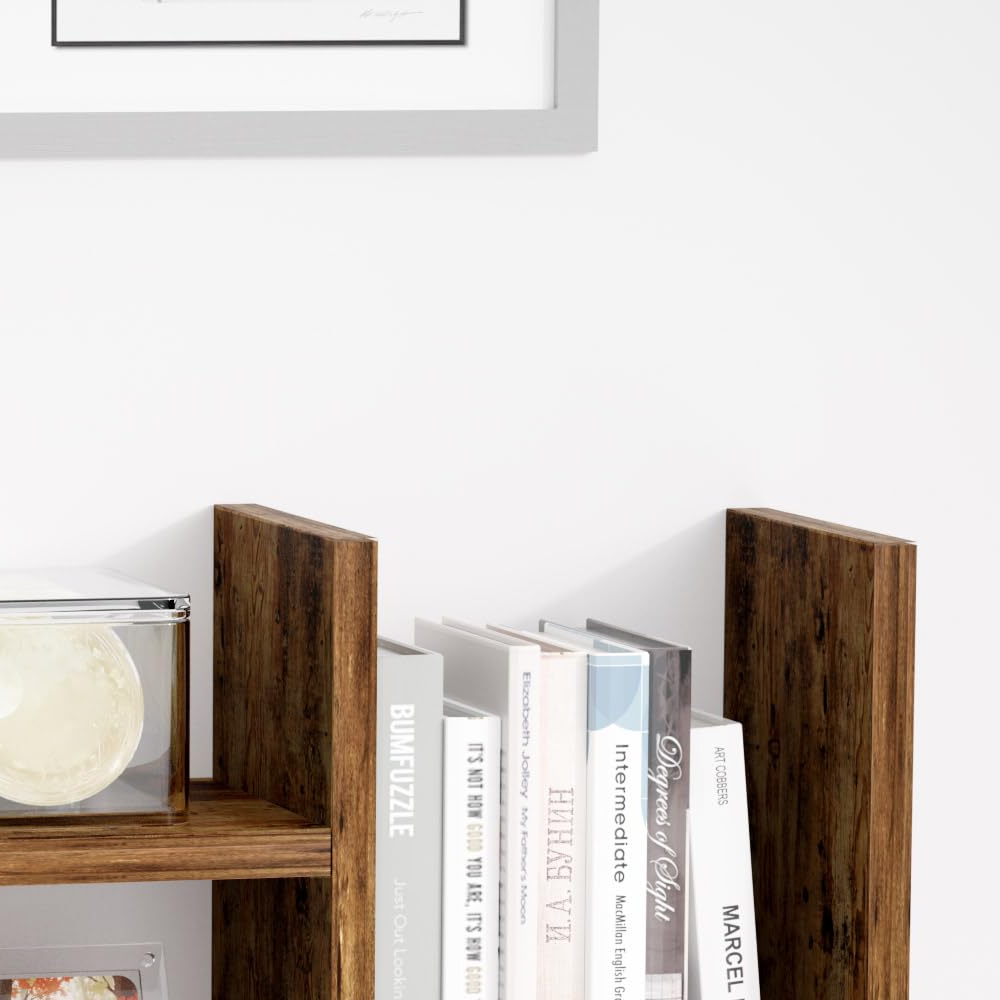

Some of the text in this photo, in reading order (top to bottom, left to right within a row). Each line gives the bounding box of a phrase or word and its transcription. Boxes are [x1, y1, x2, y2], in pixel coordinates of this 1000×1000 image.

[520, 671, 532, 798] Elizabeth Jolley
[467, 743, 483, 763] IT'S
[389, 704, 414, 838] BUMFUZZLE
[467, 768, 483, 789] NOT
[714, 747, 728, 806] ART COBBERS
[467, 795, 483, 818] HOW
[614, 744, 628, 883] Intermediate
[466, 823, 483, 852] GOOD
[546, 787, 574, 882] БУНИН
[647, 733, 683, 921] Degrees of Sight
[466, 857, 482, 878] YOU
[520, 807, 529, 925] My Father's Moon
[393, 879, 407, 909] Just
[464, 883, 482, 907] ARE,
[393, 914, 407, 944] Out
[466, 913, 482, 932] IT'S
[615, 895, 627, 944] MacMillan
[466, 937, 482, 961] HOW
[722, 905, 744, 992] MARCEL
[465, 966, 481, 994] GOOD
[612, 948, 626, 983] English
